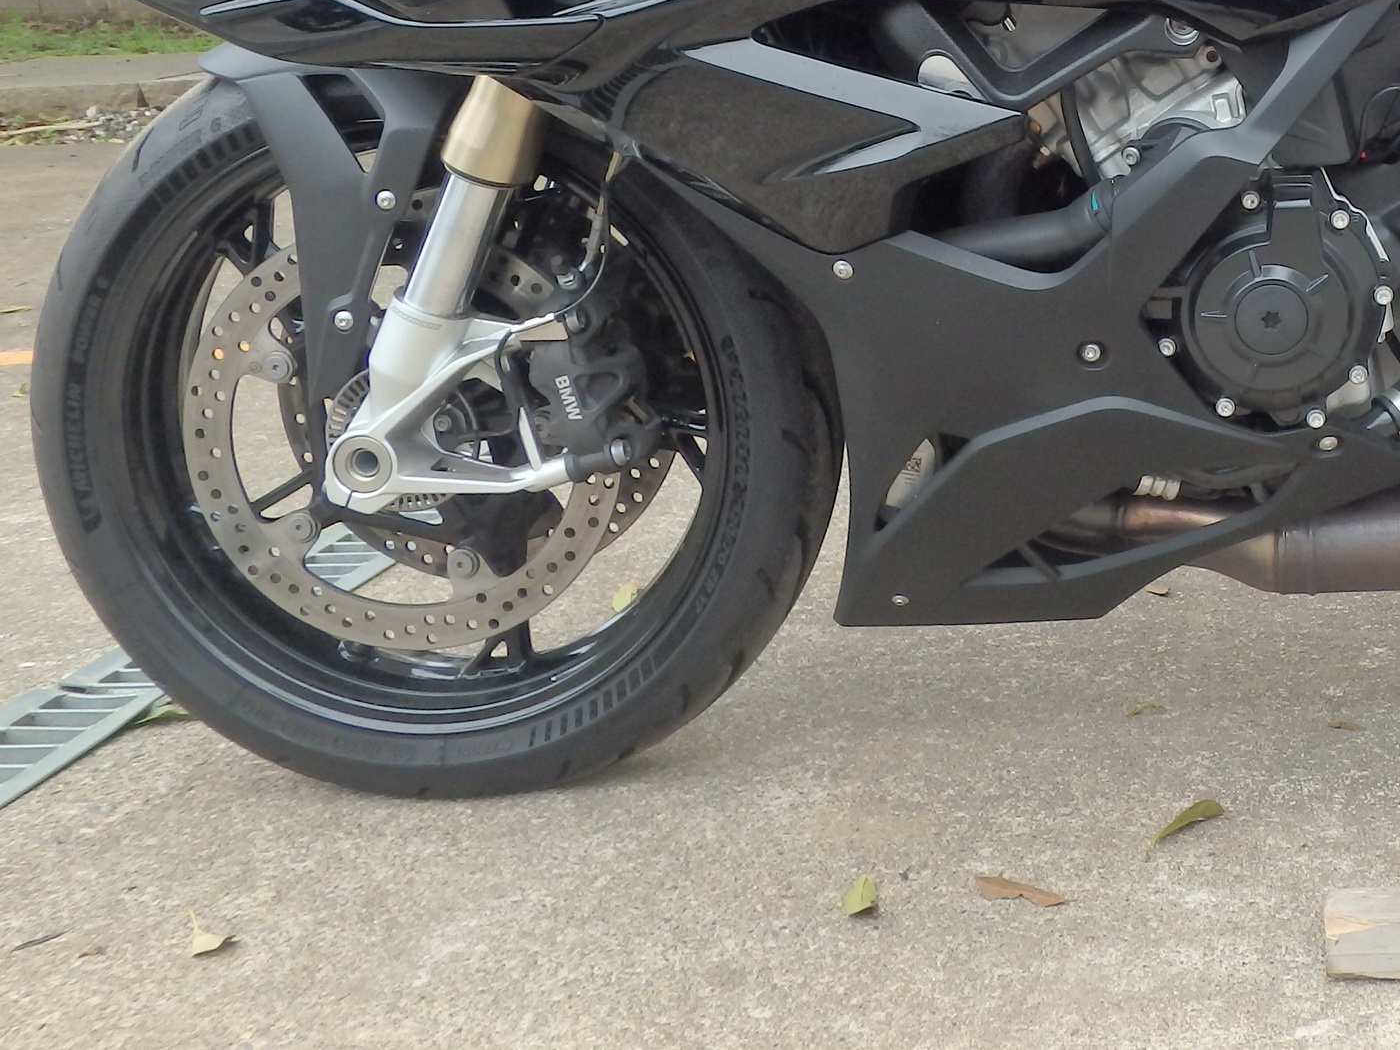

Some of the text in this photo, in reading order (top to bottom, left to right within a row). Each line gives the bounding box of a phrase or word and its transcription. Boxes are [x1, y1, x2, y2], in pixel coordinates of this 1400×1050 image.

[71, 293, 102, 364] POWER
[554, 375, 583, 421] BMW
[66, 382, 91, 491] MICHELIN
